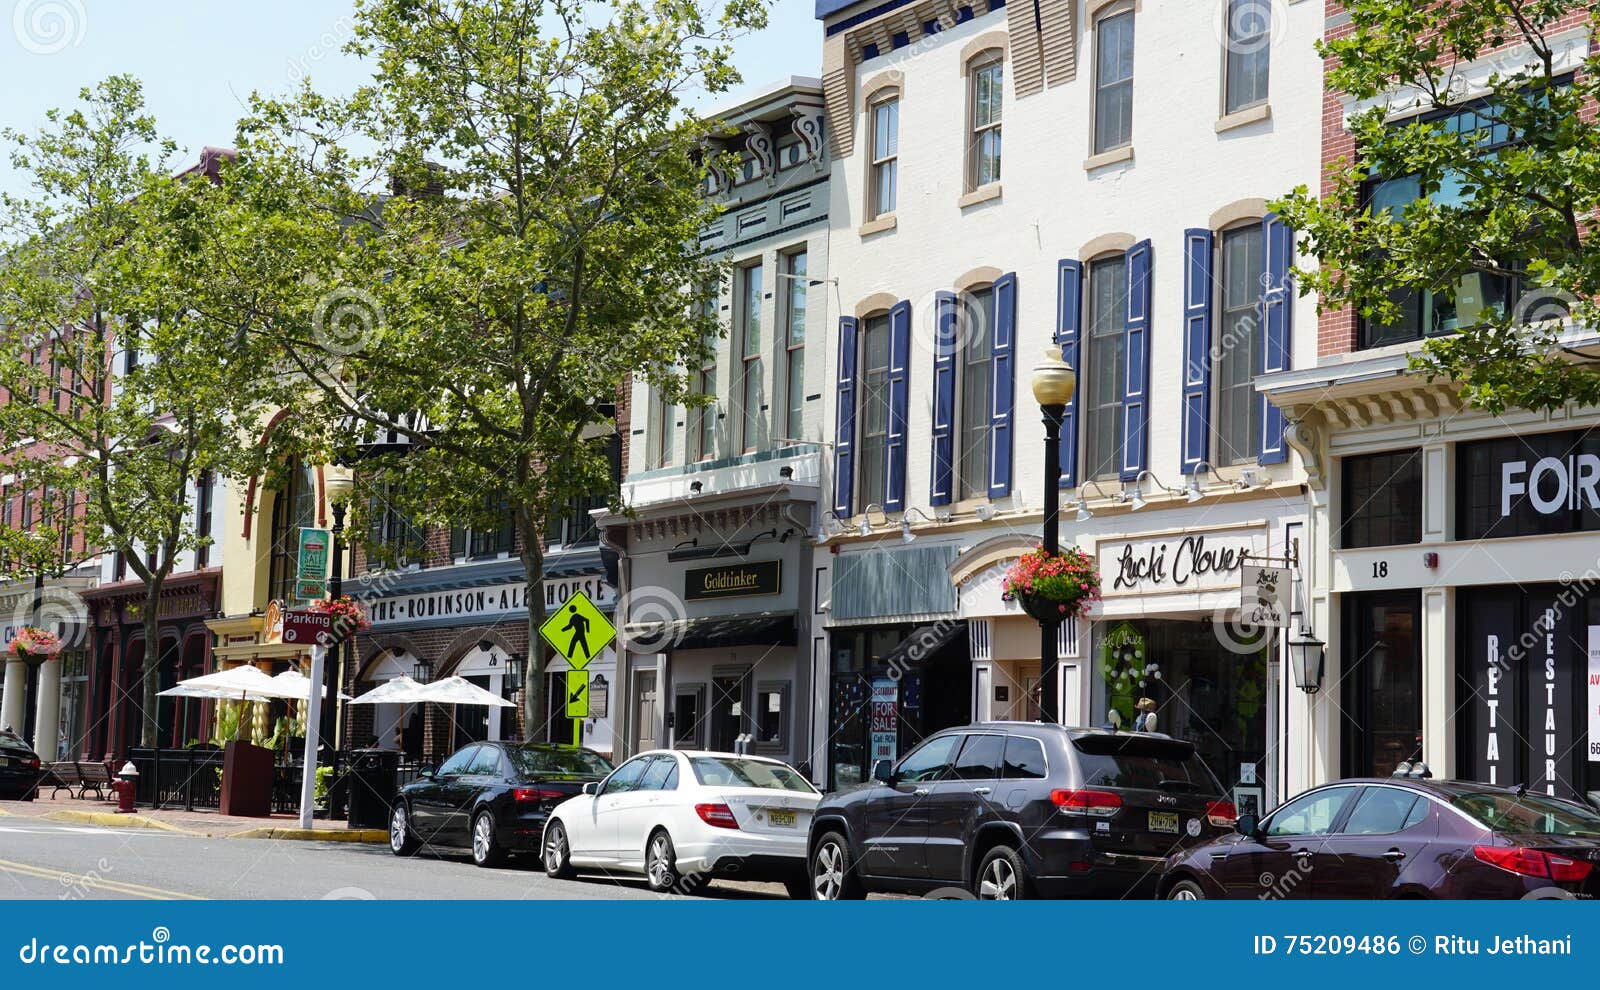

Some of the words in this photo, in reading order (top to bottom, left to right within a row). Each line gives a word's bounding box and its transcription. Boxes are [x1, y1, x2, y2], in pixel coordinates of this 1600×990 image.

[1501, 454, 1600, 516] FOR
[1113, 543, 1167, 590] Lucki
[1371, 560, 1388, 579] 18
[703, 570, 758, 590] Goldtinker
[371, 603, 396, 622] THE
[407, 590, 485, 618] ROBINSON
[499, 587, 528, 610] ALE
[546, 579, 604, 605] HOUSE
[285, 613, 330, 627] Parking
[488, 653, 497, 666] 26
[875, 702, 894, 716] FOR
[873, 717, 897, 731] SALE
